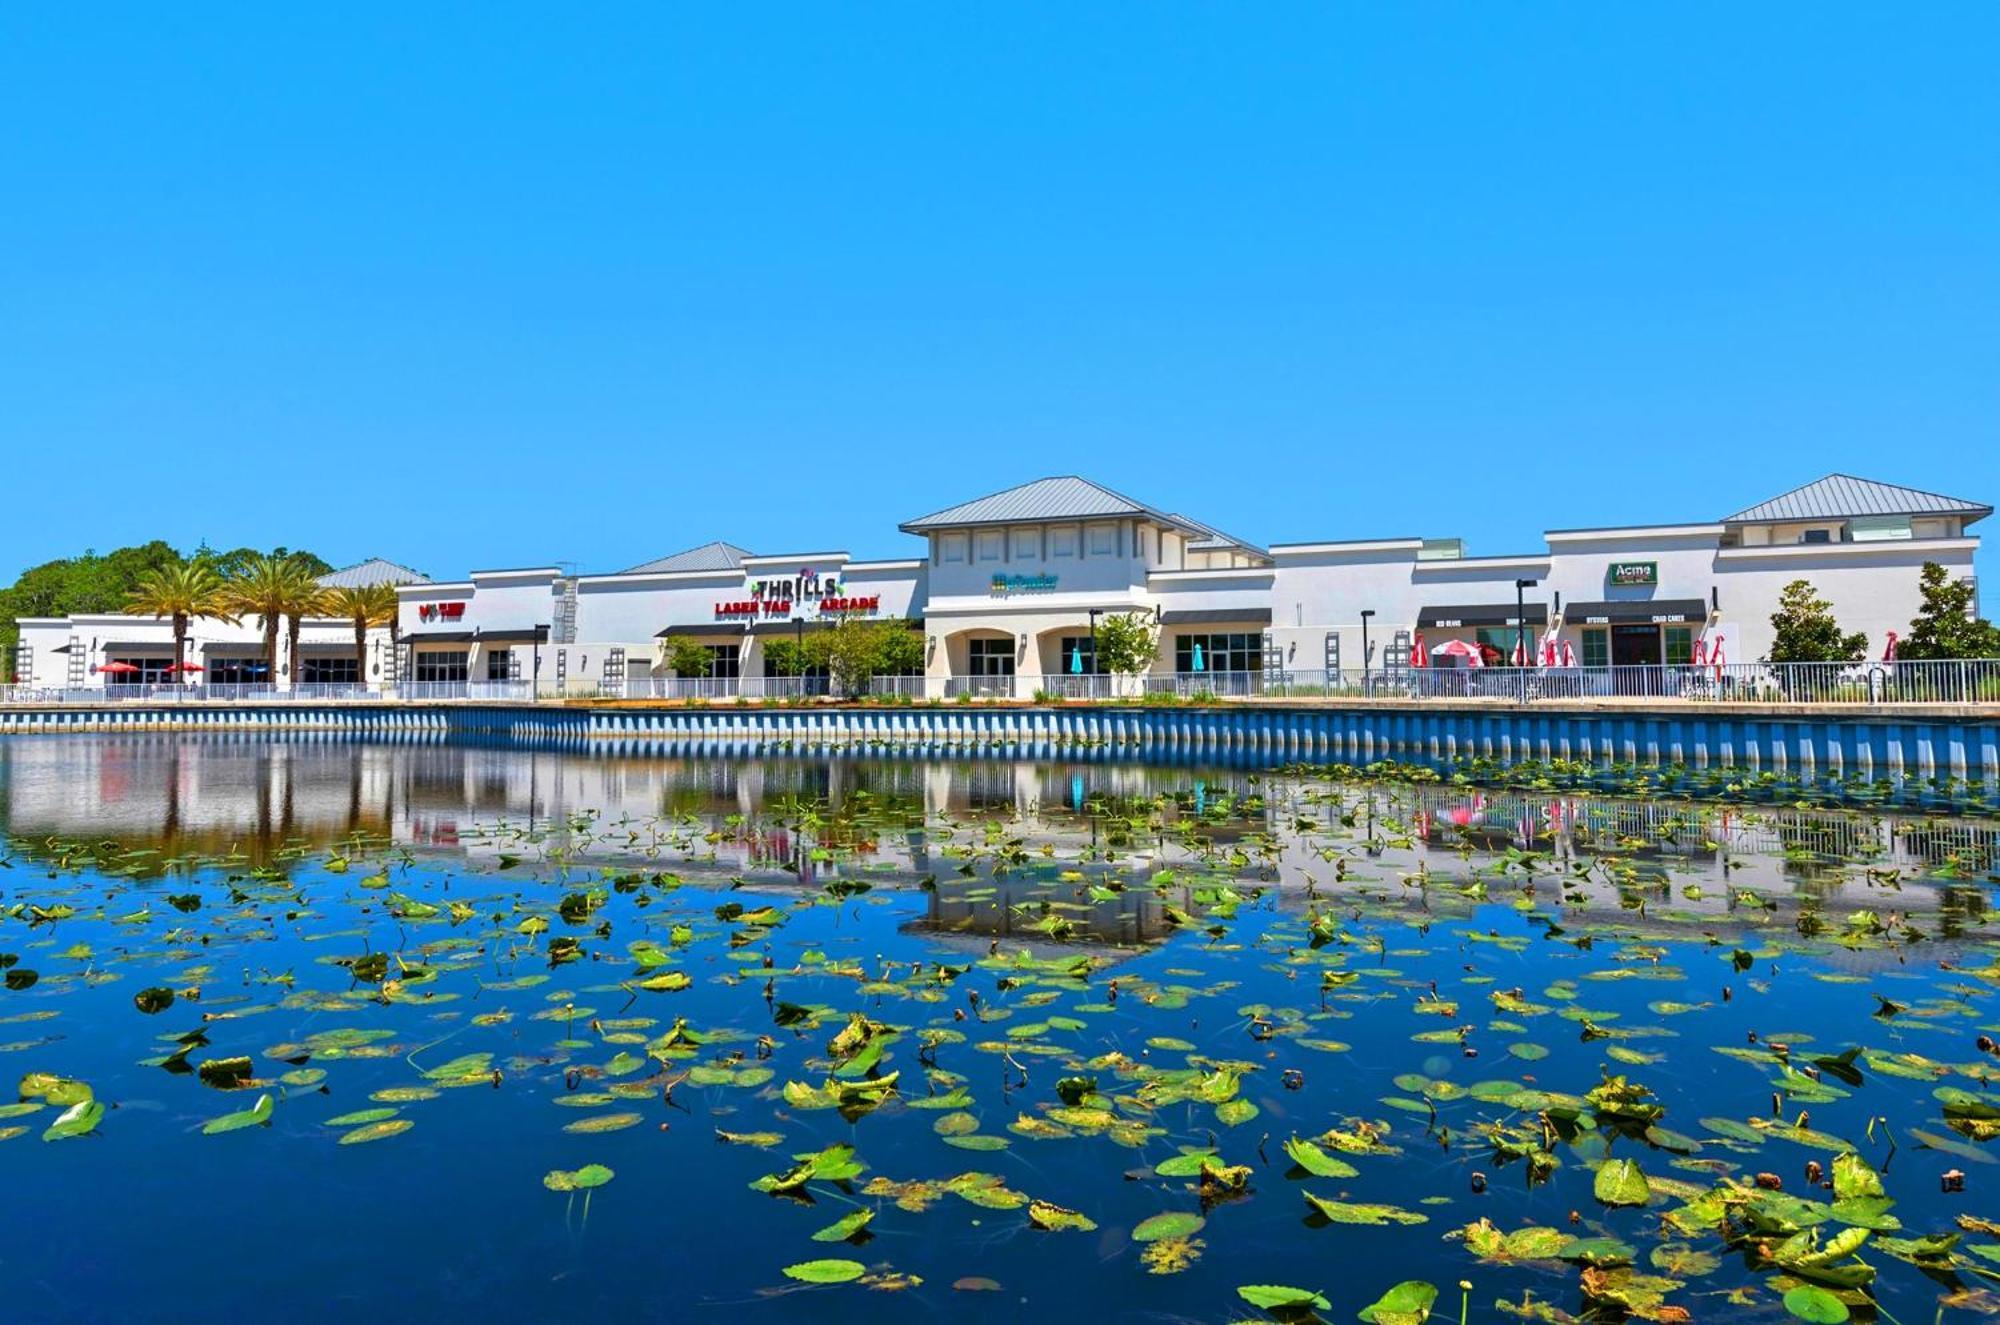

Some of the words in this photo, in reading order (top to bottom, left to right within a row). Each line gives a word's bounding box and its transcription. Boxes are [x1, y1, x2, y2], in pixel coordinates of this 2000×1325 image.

[1616, 564, 1651, 576] Acme
[757, 577, 836, 600] THRILLS
[715, 601, 759, 614] LASER
[763, 600, 791, 613] TAG
[820, 597, 879, 611] ARCADE
